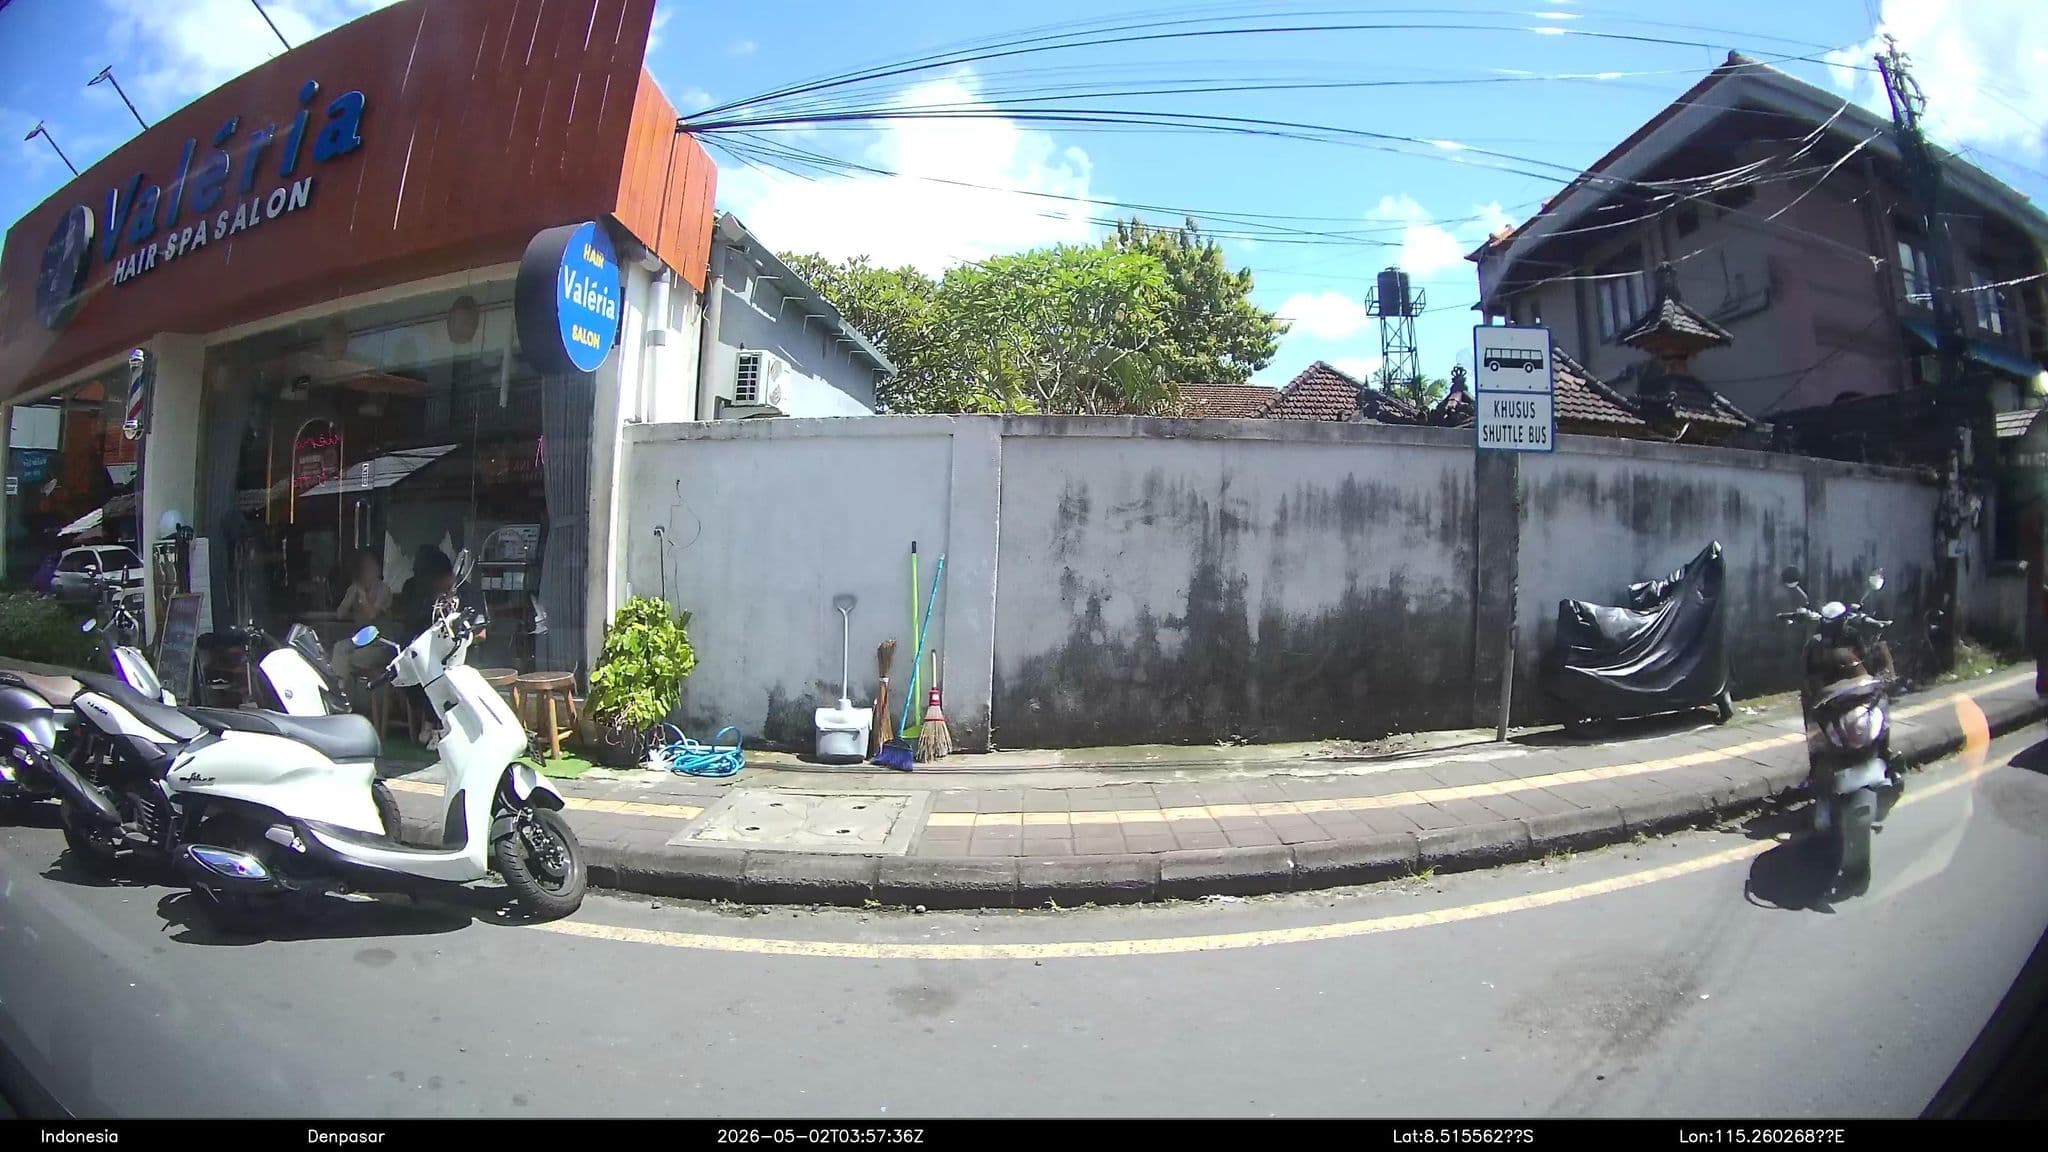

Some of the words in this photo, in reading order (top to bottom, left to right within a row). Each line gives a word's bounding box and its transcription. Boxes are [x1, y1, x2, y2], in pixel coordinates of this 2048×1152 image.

[104, 80, 365, 262] Valéria
[112, 243, 158, 286] HAIR
[164, 219, 208, 261] SPA
[214, 176, 313, 240] SALON
[583, 243, 605, 269] HAIR
[564, 265, 615, 320] Valéria
[572, 324, 601, 349] SALON
[1493, 400, 1536, 418] KHUSUS
[1483, 424, 1523, 443] SHUTTLE
[1528, 426, 1547, 444] BUS
